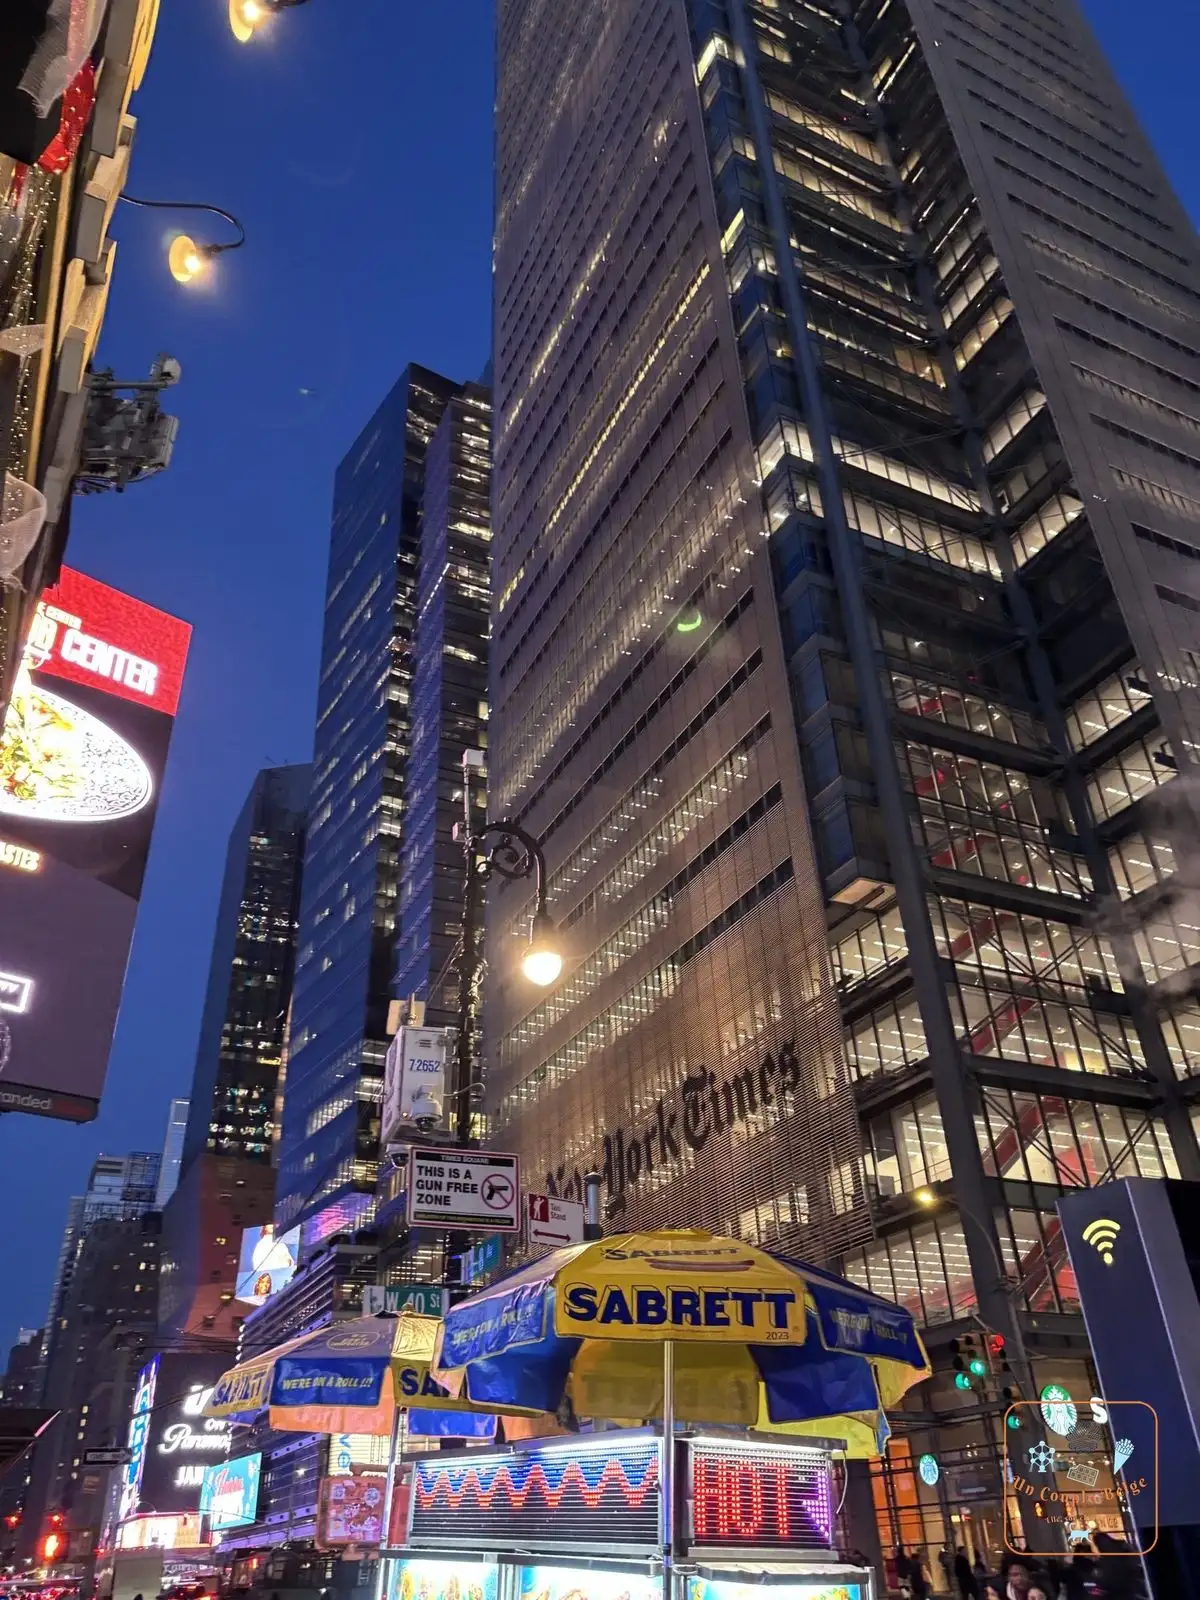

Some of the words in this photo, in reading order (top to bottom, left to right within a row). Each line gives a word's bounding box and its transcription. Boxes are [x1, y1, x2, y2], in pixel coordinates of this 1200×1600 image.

[61, 628, 158, 696] CENTER
[409, 1058, 440, 1073] 72652
[0, 1091, 52, 1110] anded
[463, 1156, 490, 1165] SQUARE
[416, 1165, 445, 1178] THIS
[448, 1168, 460, 1180] IS
[463, 1169, 472, 1181] A
[416, 1179, 442, 1192] GUN
[446, 1182, 478, 1194] FREE
[416, 1193, 451, 1206] ZONE
[385, 1291, 400, 1313] W
[406, 1291, 425, 1315] 40
[430, 1292, 441, 1308] St
[564, 1282, 796, 1329] SABRETT
[765, 1331, 789, 1340] 2023
[335, 1377, 357, 1388] ROLL
[694, 1457, 792, 1536] HOT
